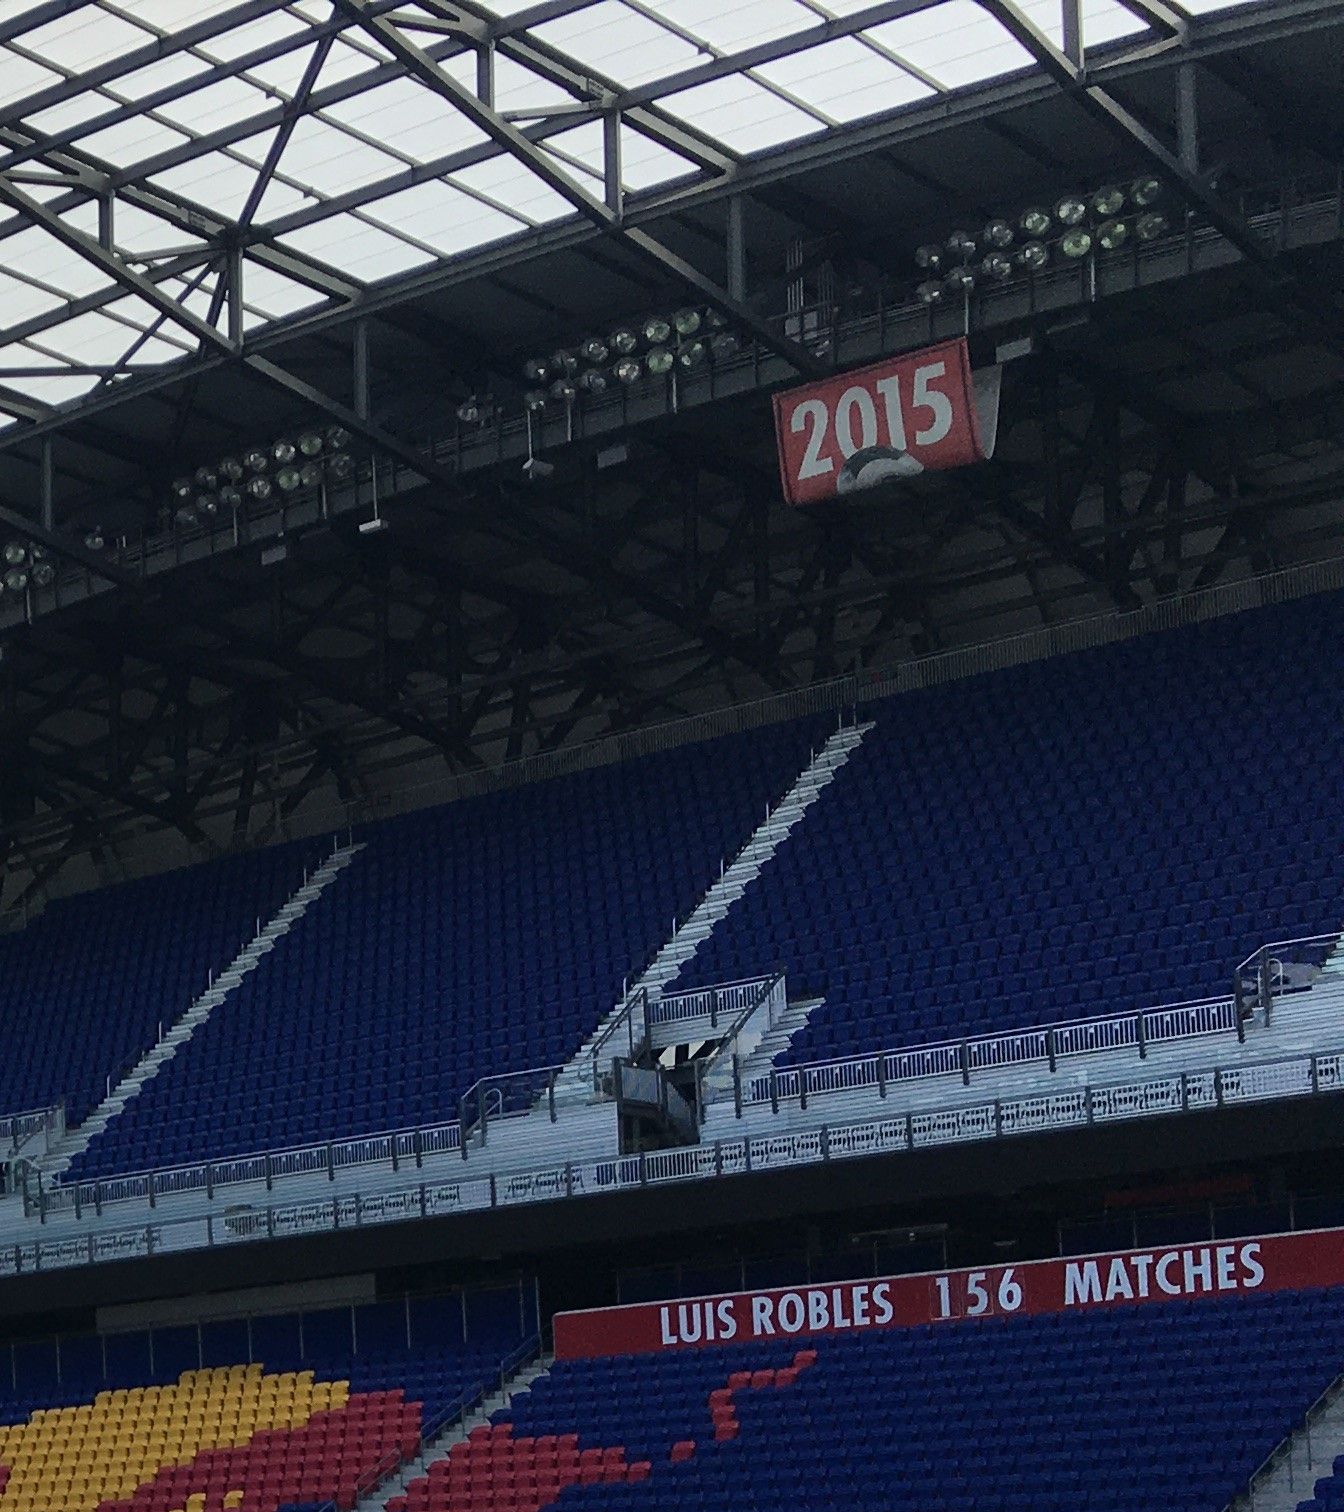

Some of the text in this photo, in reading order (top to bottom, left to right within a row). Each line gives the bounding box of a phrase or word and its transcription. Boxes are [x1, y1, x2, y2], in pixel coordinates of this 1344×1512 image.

[790, 361, 953, 481] 2015
[660, 1242, 1266, 1346] LUIS ROBLES 156 MATCHES
